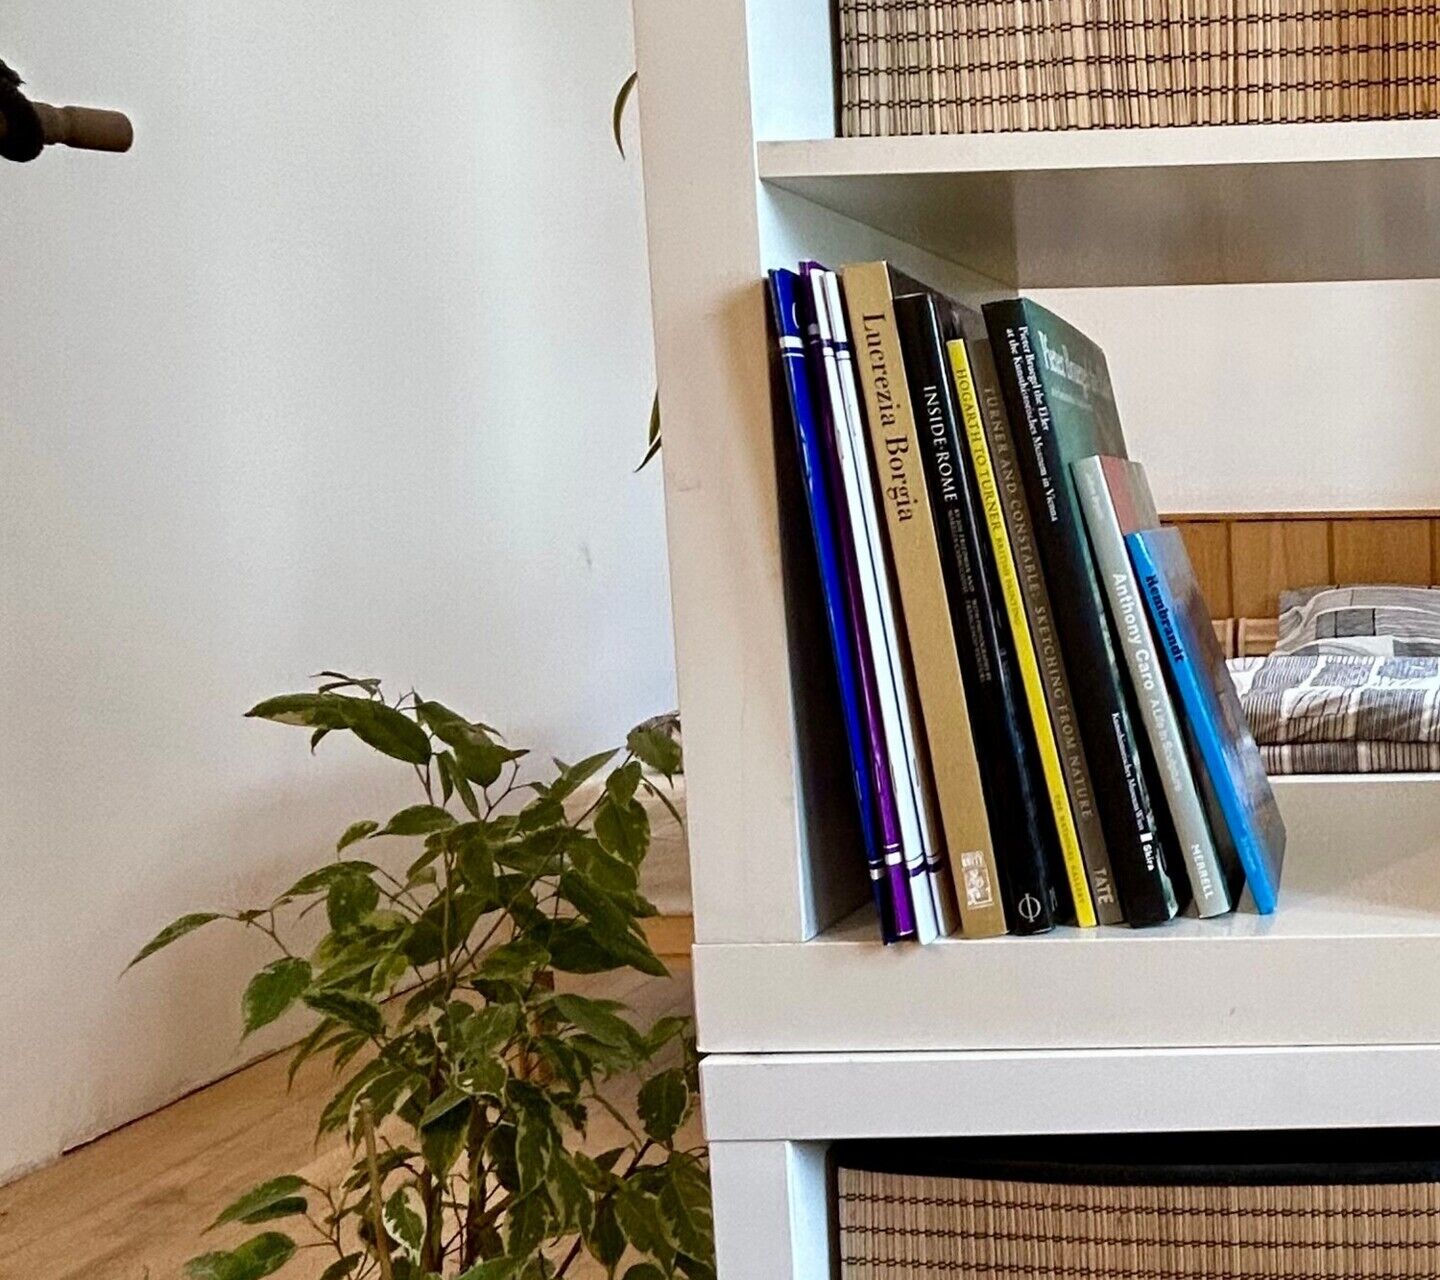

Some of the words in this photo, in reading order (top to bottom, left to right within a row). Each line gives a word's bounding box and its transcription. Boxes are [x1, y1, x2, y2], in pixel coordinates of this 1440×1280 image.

[862, 311, 903, 426] Lucrezia
[883, 434, 920, 523] Borgia
[954, 367, 982, 442] HOGARTH
[972, 446, 987, 467] TO
[978, 470, 1002, 531] TURNER
[982, 385, 1009, 453] TURNER
[999, 458, 1018, 494] AND
[1033, 605, 1064, 698] SKETCHING
[1056, 704, 1076, 749] FROM
[1067, 754, 1093, 819] NATURE
[1111, 570, 1143, 646] Anthony
[1133, 647, 1158, 691] Caro
[1144, 573, 1188, 663] Rembrandt
[1090, 867, 1114, 905] TATE
[1141, 843, 1157, 871] Skira
[1189, 843, 1214, 899] MERRELL
